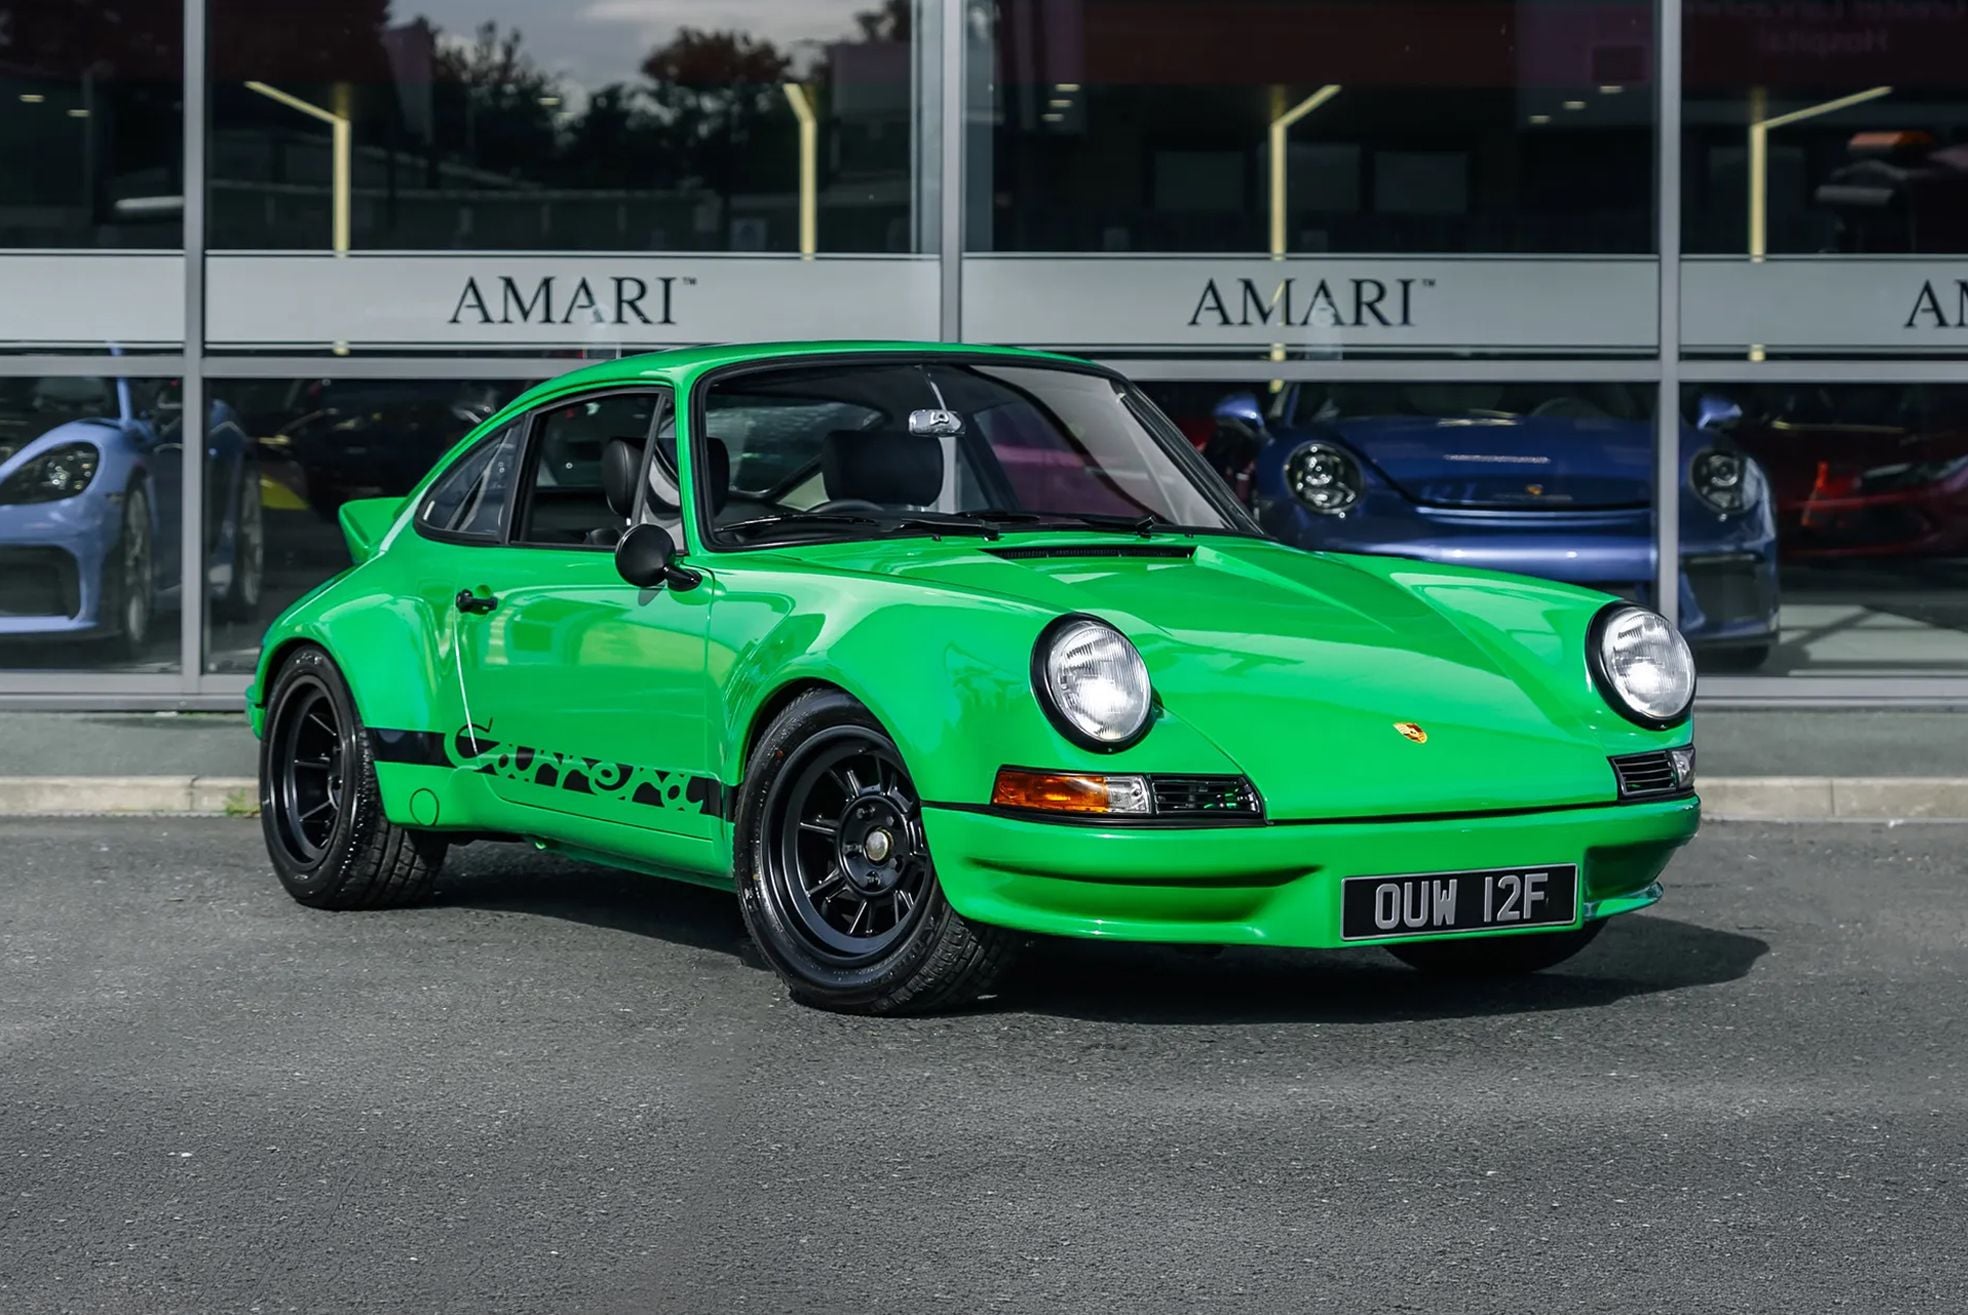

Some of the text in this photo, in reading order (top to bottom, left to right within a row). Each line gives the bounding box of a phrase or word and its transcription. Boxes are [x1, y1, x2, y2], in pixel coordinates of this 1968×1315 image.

[448, 276, 677, 325] AMARI
[1188, 278, 1416, 326] AMARI
[1903, 279, 1968, 328] A
[443, 717, 704, 813] Carrera
[1375, 873, 1549, 930] OUW 12F
